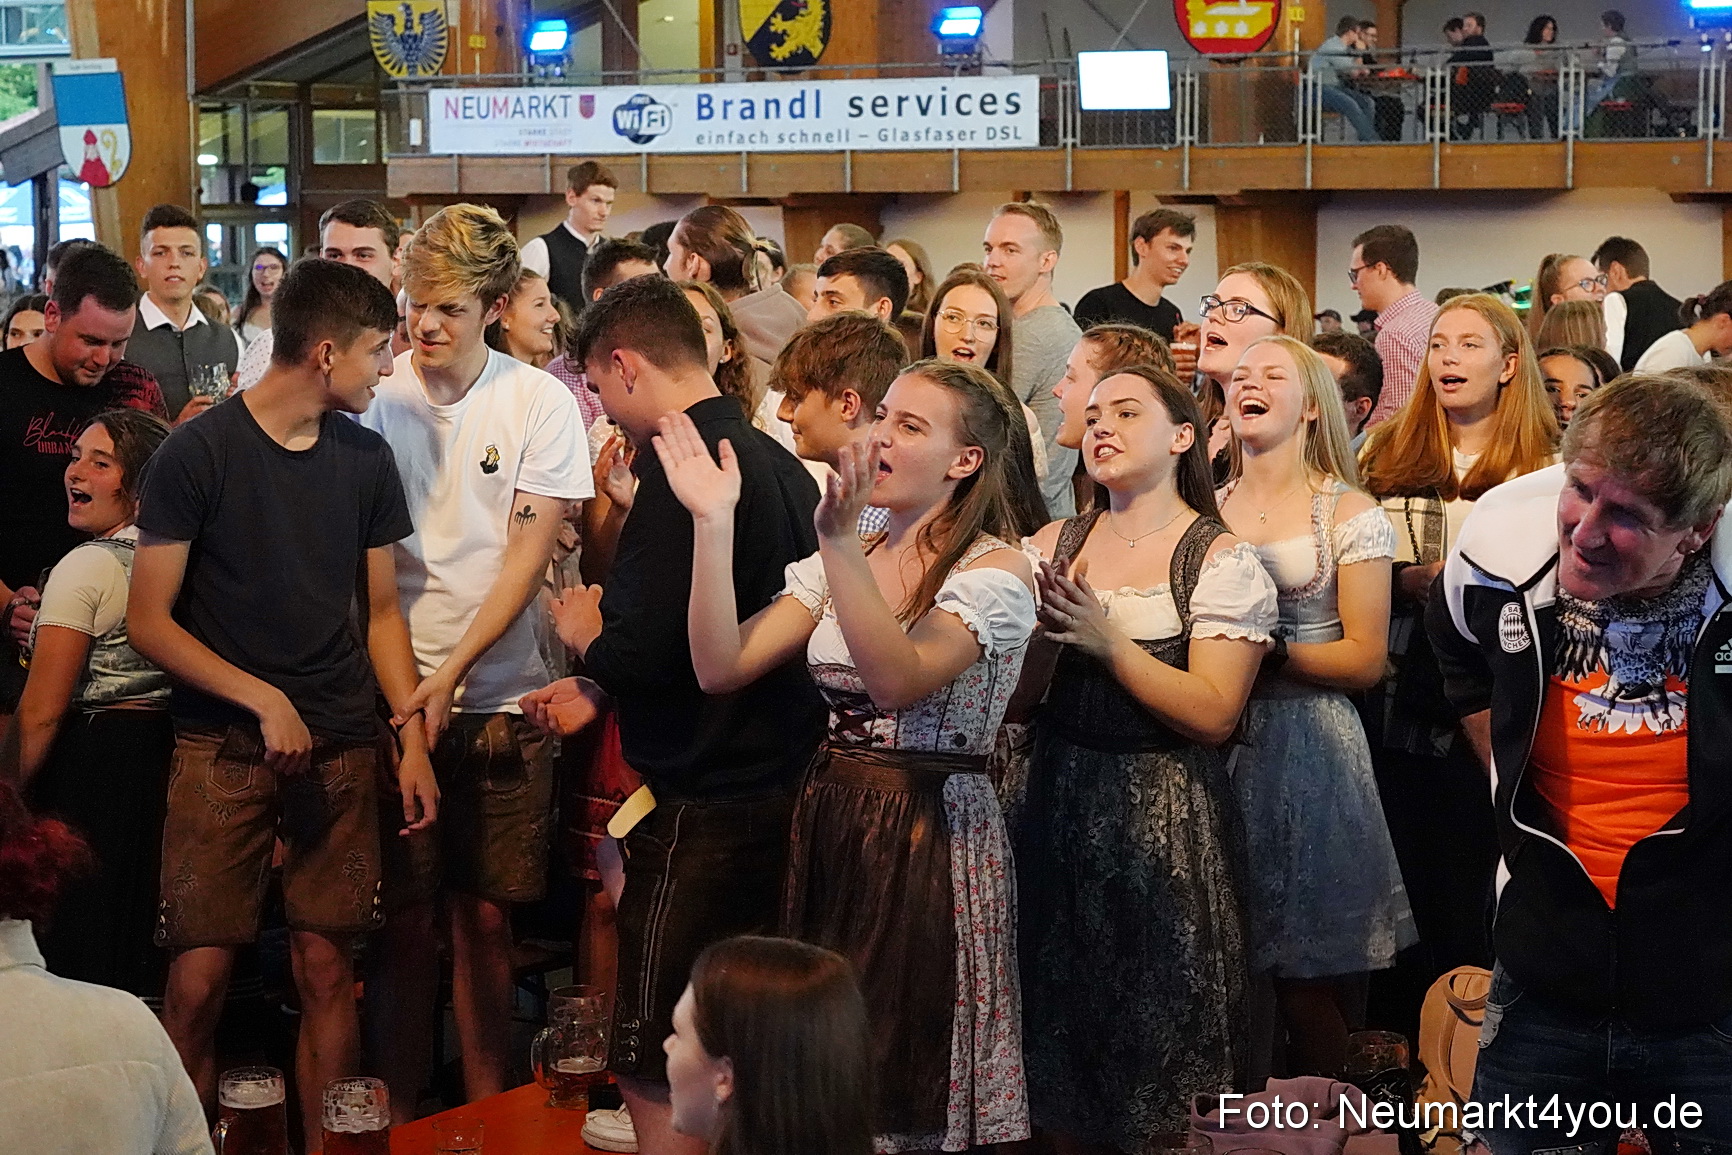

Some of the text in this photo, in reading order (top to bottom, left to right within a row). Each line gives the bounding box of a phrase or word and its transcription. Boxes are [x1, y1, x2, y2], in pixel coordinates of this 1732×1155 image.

[444, 95, 572, 119] NEUMARKT
[696, 86, 1021, 120] Brandl services
[696, 130, 769, 145] einfach
[778, 128, 850, 144] schnell
[877, 127, 977, 142] Glasfaser
[986, 125, 1022, 141] DSL
